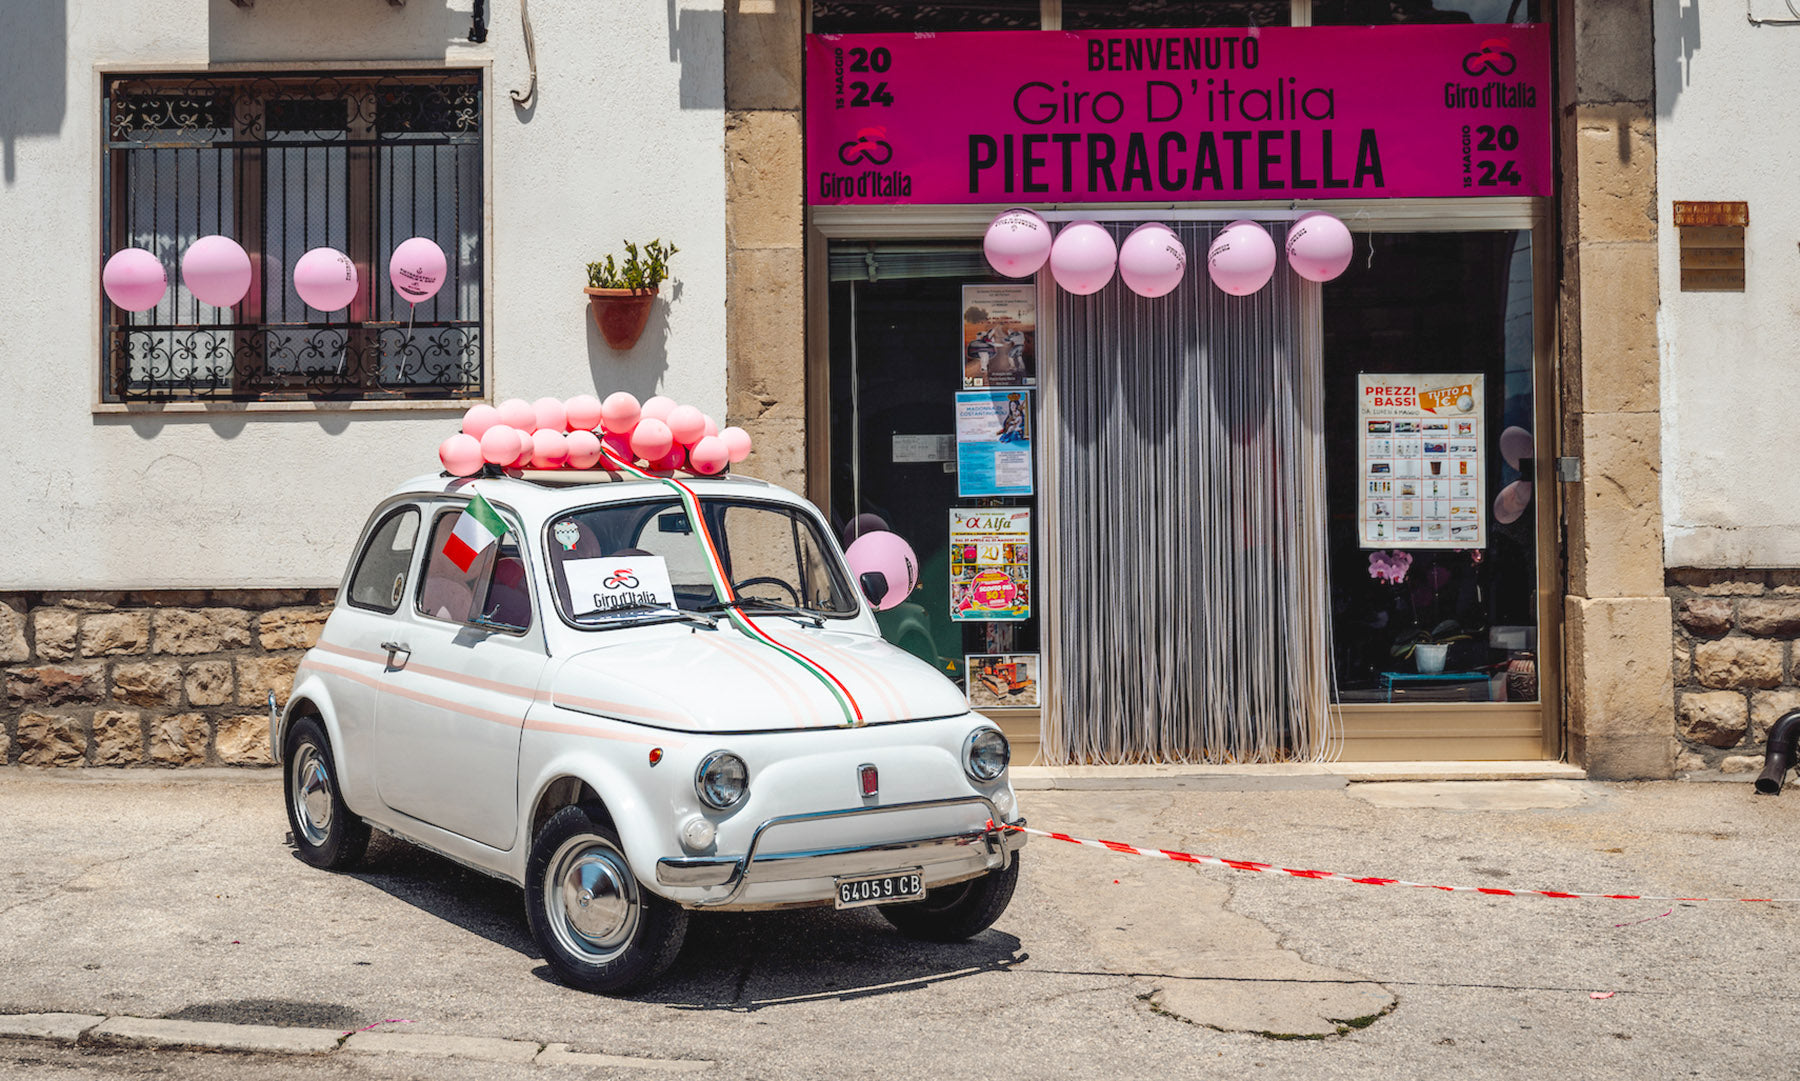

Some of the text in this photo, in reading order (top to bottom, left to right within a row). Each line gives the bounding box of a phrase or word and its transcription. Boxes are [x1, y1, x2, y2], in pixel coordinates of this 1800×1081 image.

[848, 47, 892, 73] 20
[1087, 36, 1259, 71] BENVENUTO
[834, 48, 845, 110] 15 MAGGIO
[849, 81, 894, 108] 24
[1013, 76, 1335, 125] Giro D'italia
[1444, 81, 1537, 108] Giro d'Italia
[1475, 125, 1519, 151] 20
[968, 129, 1385, 194] PIETRACATELLA
[1462, 125, 1472, 188] 15 MAGGIO
[820, 170, 912, 198] Giro d'Italia
[1476, 160, 1522, 186] 24
[1365, 386, 1416, 396] PREZZI
[1374, 397, 1416, 407] BASSI
[1427, 386, 1469, 399] TUTTO A
[983, 517, 1011, 531] Alfa
[981, 545, 999, 560] 20
[593, 591, 657, 608] Giro d'Italia
[986, 590, 998, 600] 50
[842, 875, 920, 901] 64059 CB
